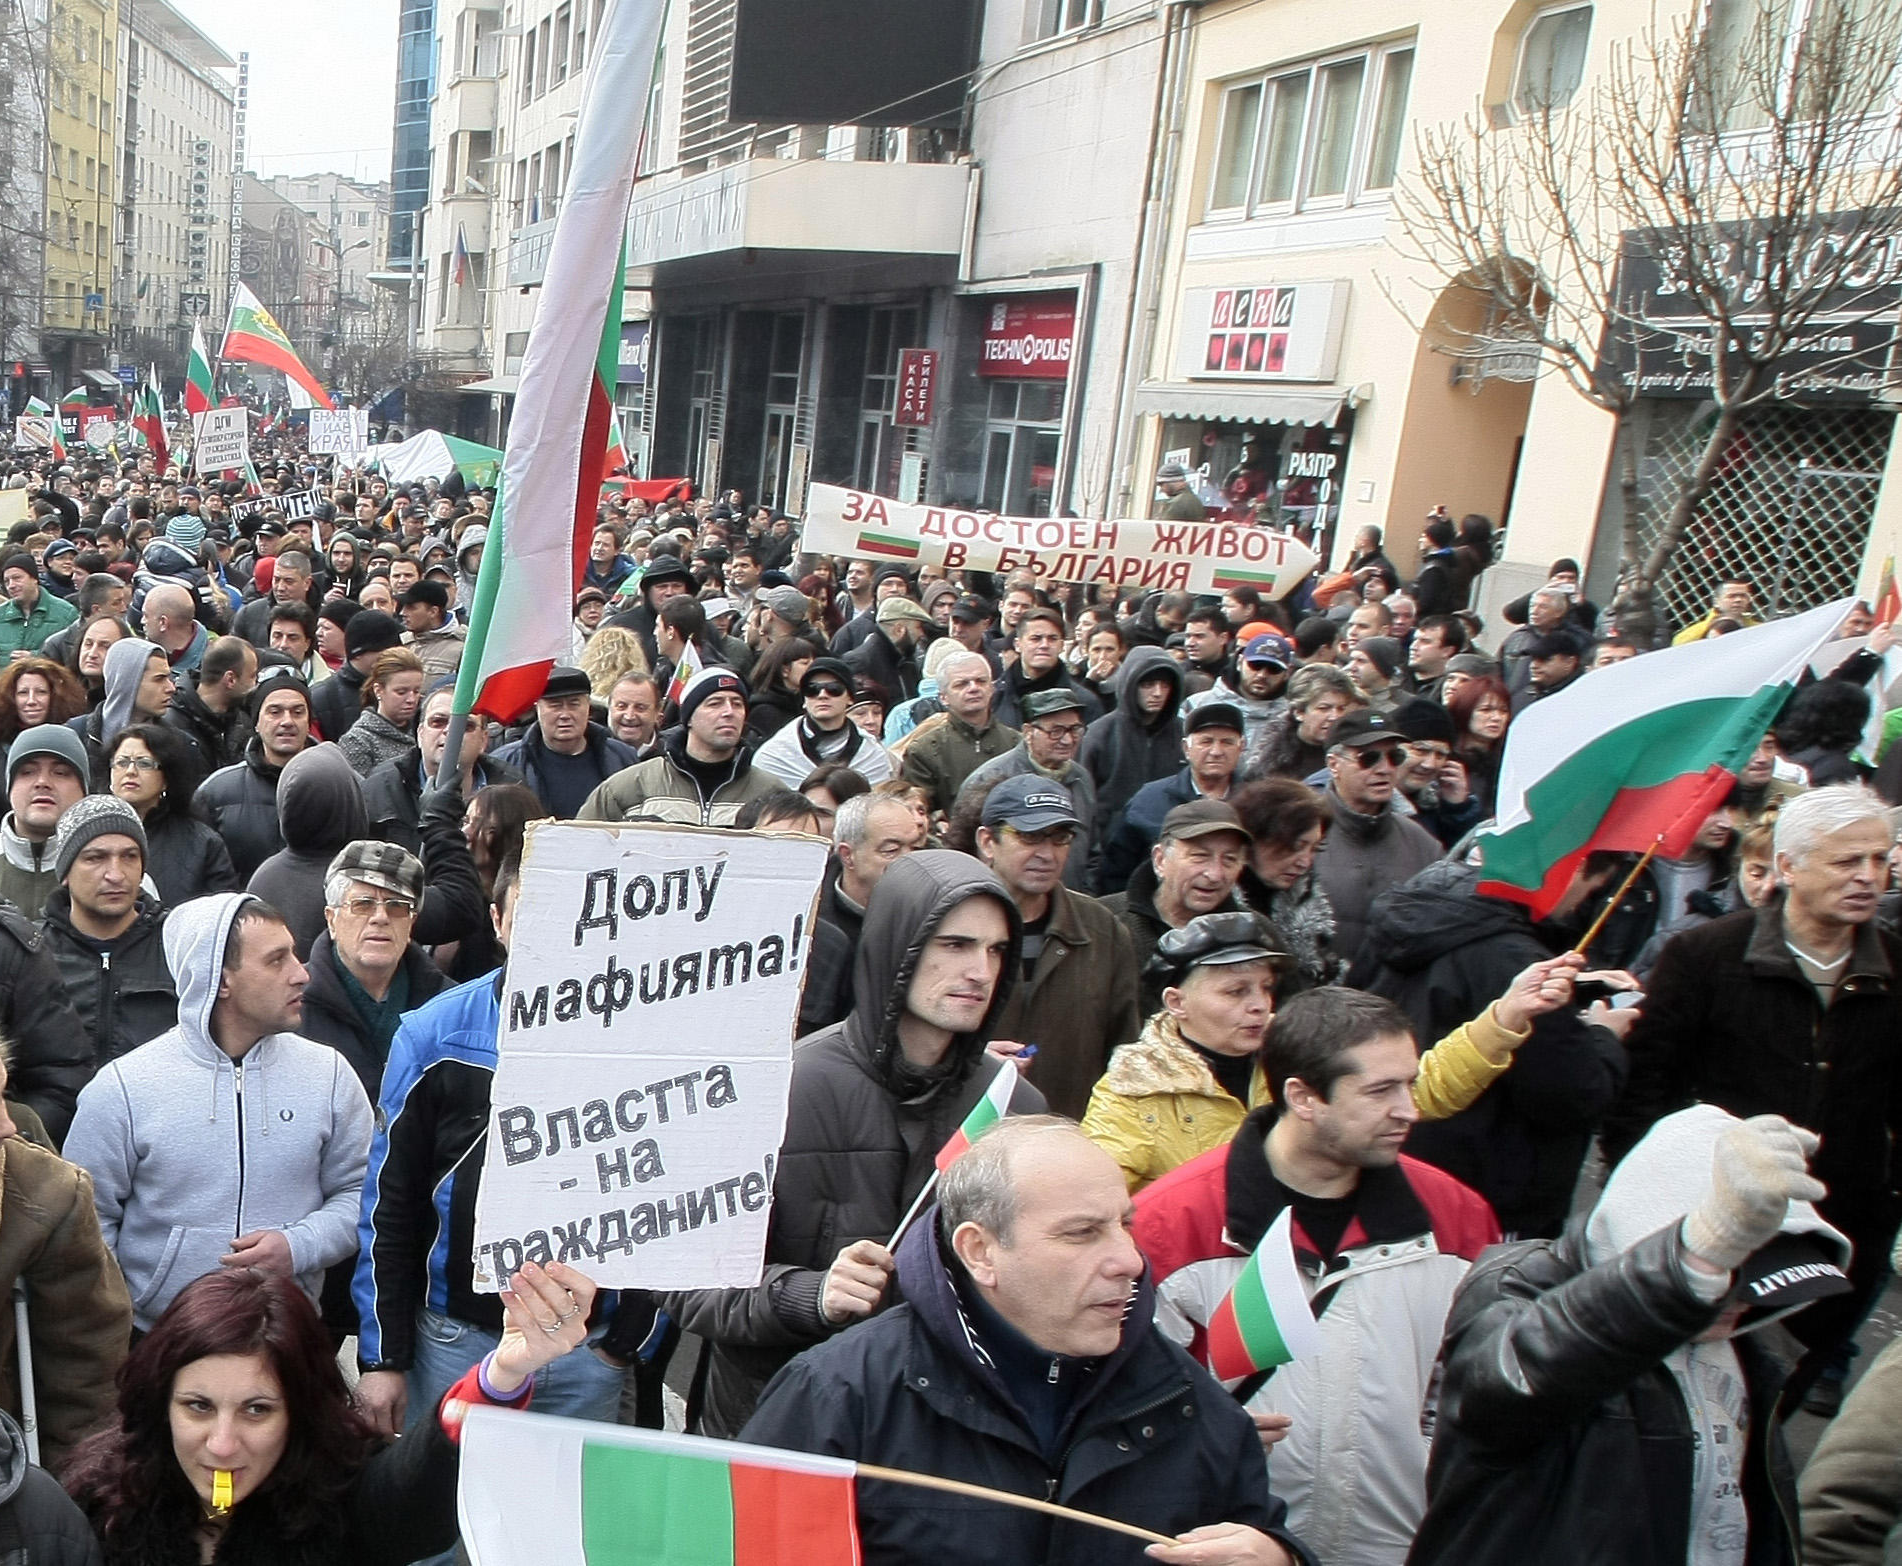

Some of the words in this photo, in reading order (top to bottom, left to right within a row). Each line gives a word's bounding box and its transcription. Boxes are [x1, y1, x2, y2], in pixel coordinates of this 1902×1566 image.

[985, 334, 1071, 365] TECHNOPOLIS
[903, 364, 917, 412] КАСА
[915, 355, 931, 421] БИЛЕТИ
[840, 491, 889, 527] ЗА
[919, 508, 1120, 552] ДОСТОЕН
[1151, 524, 1291, 567] ЖИВОТ
[943, 542, 967, 569] В
[996, 546, 1191, 591] БЪЛГАРИЯ
[573, 859, 728, 947] Долу
[508, 913, 805, 1032] мафията!
[498, 1064, 739, 1167] Властта
[597, 1137, 665, 1194] на
[474, 1153, 775, 1290] гражданите!
